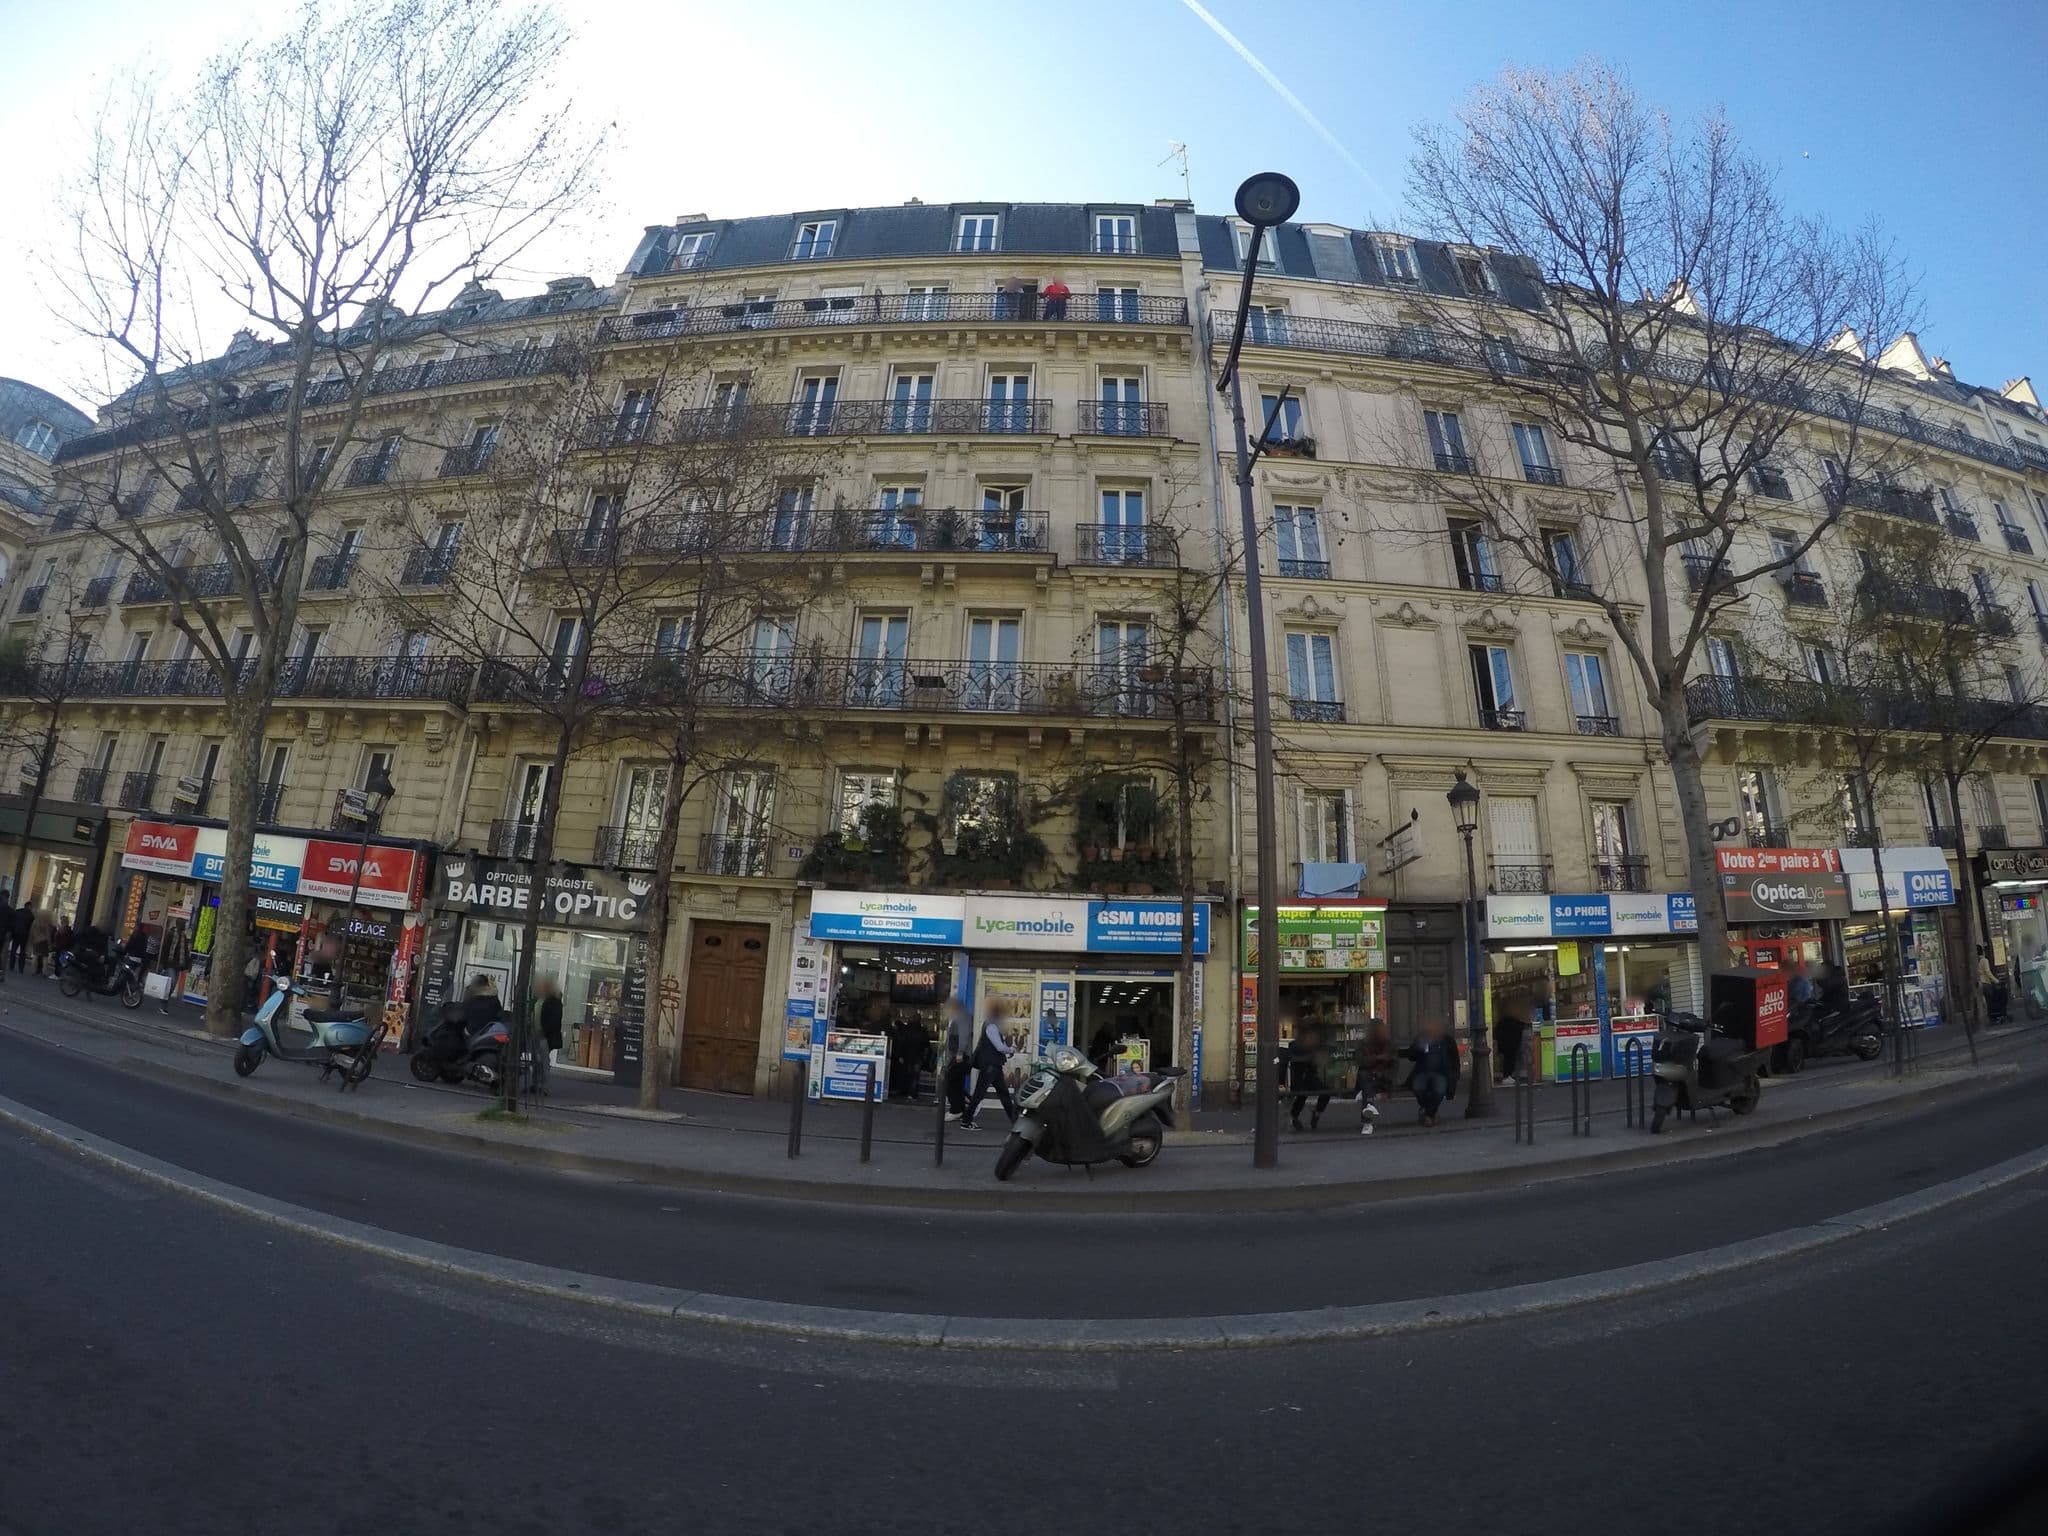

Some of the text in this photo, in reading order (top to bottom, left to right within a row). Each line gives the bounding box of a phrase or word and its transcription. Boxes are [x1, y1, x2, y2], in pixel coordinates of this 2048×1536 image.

[1721, 852, 1755, 868] Votre
[1758, 852, 1777, 868] 2ème
[1780, 853, 1809, 872] paire
[1812, 853, 1819, 868] à
[249, 864, 285, 881] OBILE
[486, 871, 594, 890] OPTICIEN ISAGISTE
[1911, 874, 1946, 891] ONE
[308, 884, 327, 893] MARIO
[329, 887, 351, 896] PHONE
[1757, 883, 1825, 903] OpticaLya
[1859, 887, 1900, 899] Lycambile
[1913, 891, 1948, 903] PHONE
[257, 897, 303, 915] BIENVENUE
[555, 892, 637, 920] OPTIC
[860, 901, 917, 912] Lycamobile
[1672, 897, 1684, 908] FS
[1097, 911, 1199, 926] GSM MOBIE
[1574, 905, 1607, 917] PHONE
[1616, 911, 1662, 921] Lycamobile
[976, 916, 1074, 933] Lycamobile
[1492, 914, 1544, 925] Lycamobile
[356, 921, 387, 937] PLACE
[896, 973, 935, 985] PROMOS
[1764, 989, 1784, 1004] ALLO
[1760, 1001, 1784, 1017] RESTO
